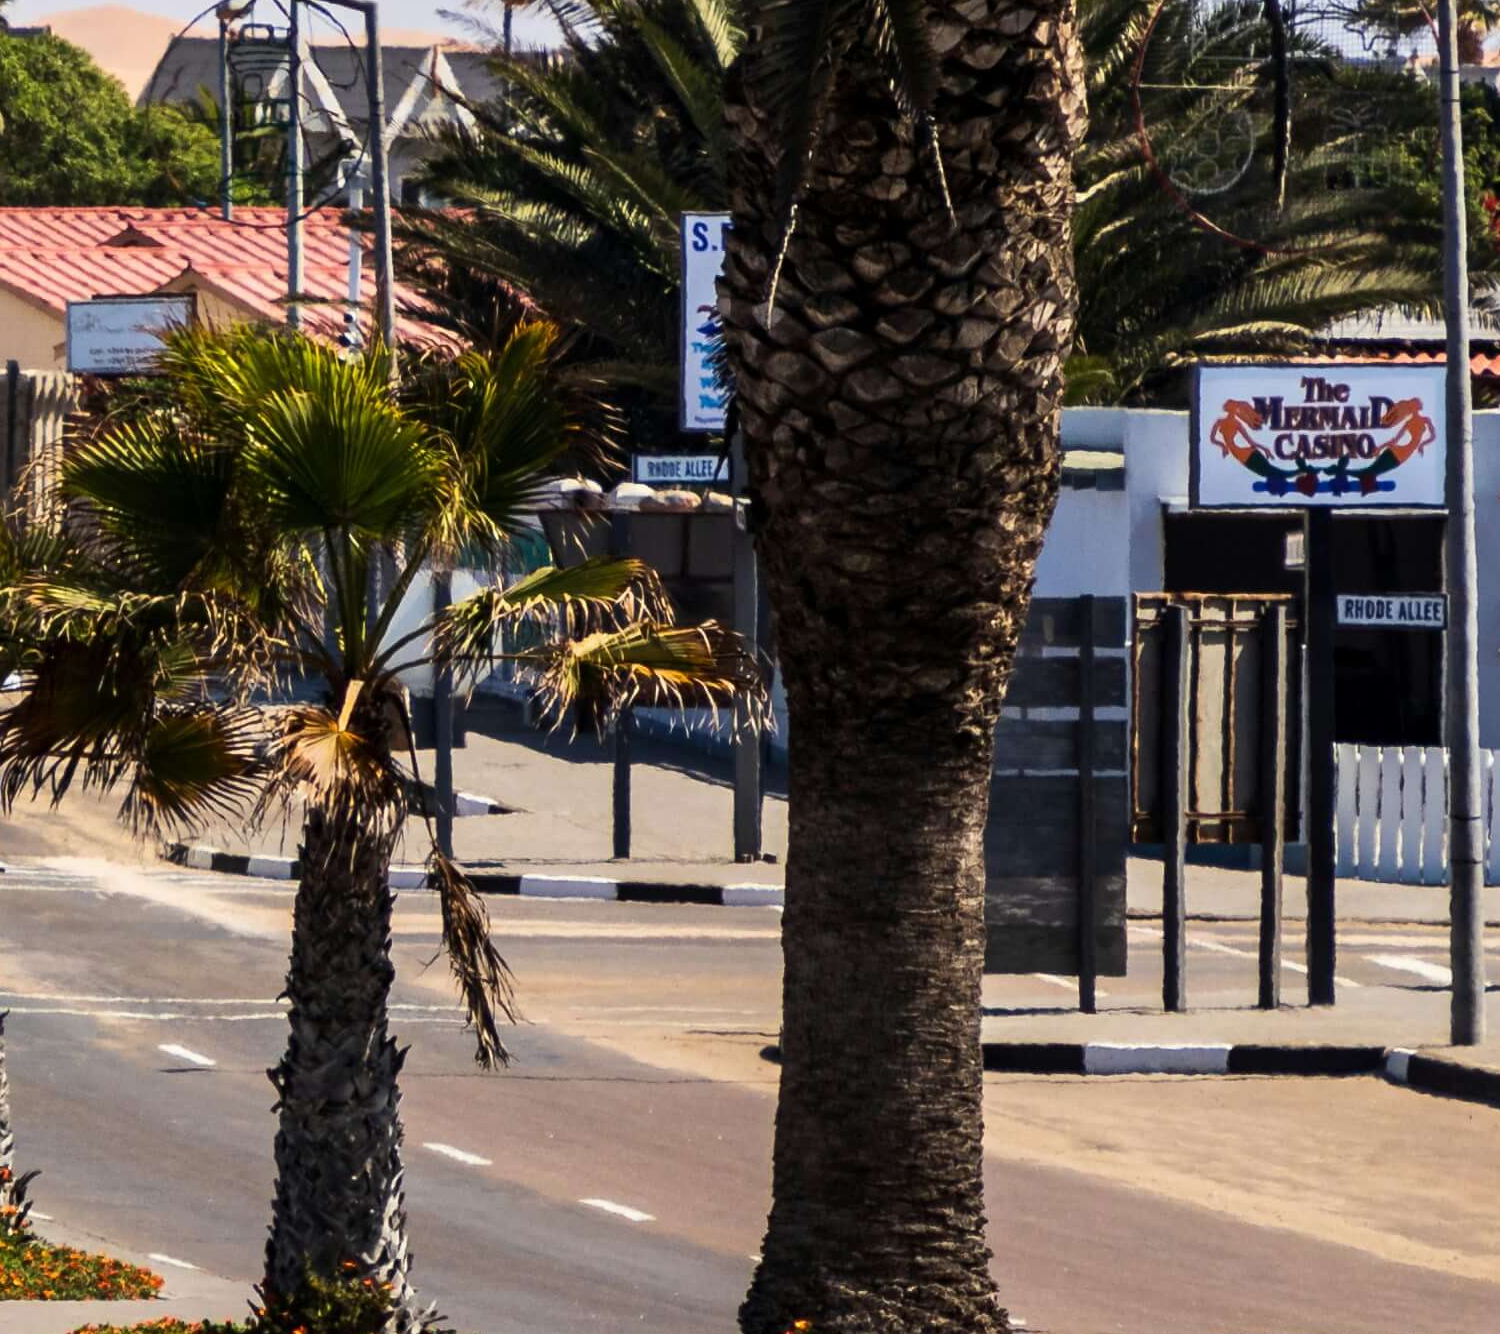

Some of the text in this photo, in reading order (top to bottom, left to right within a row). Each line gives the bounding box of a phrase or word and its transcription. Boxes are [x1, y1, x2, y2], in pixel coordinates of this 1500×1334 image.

[1301, 376, 1350, 403] The
[1274, 433, 1377, 460] CASINO
[647, 461, 714, 477] RHODE ALLEE
[1345, 599, 1441, 620] RHODE ALLEE
